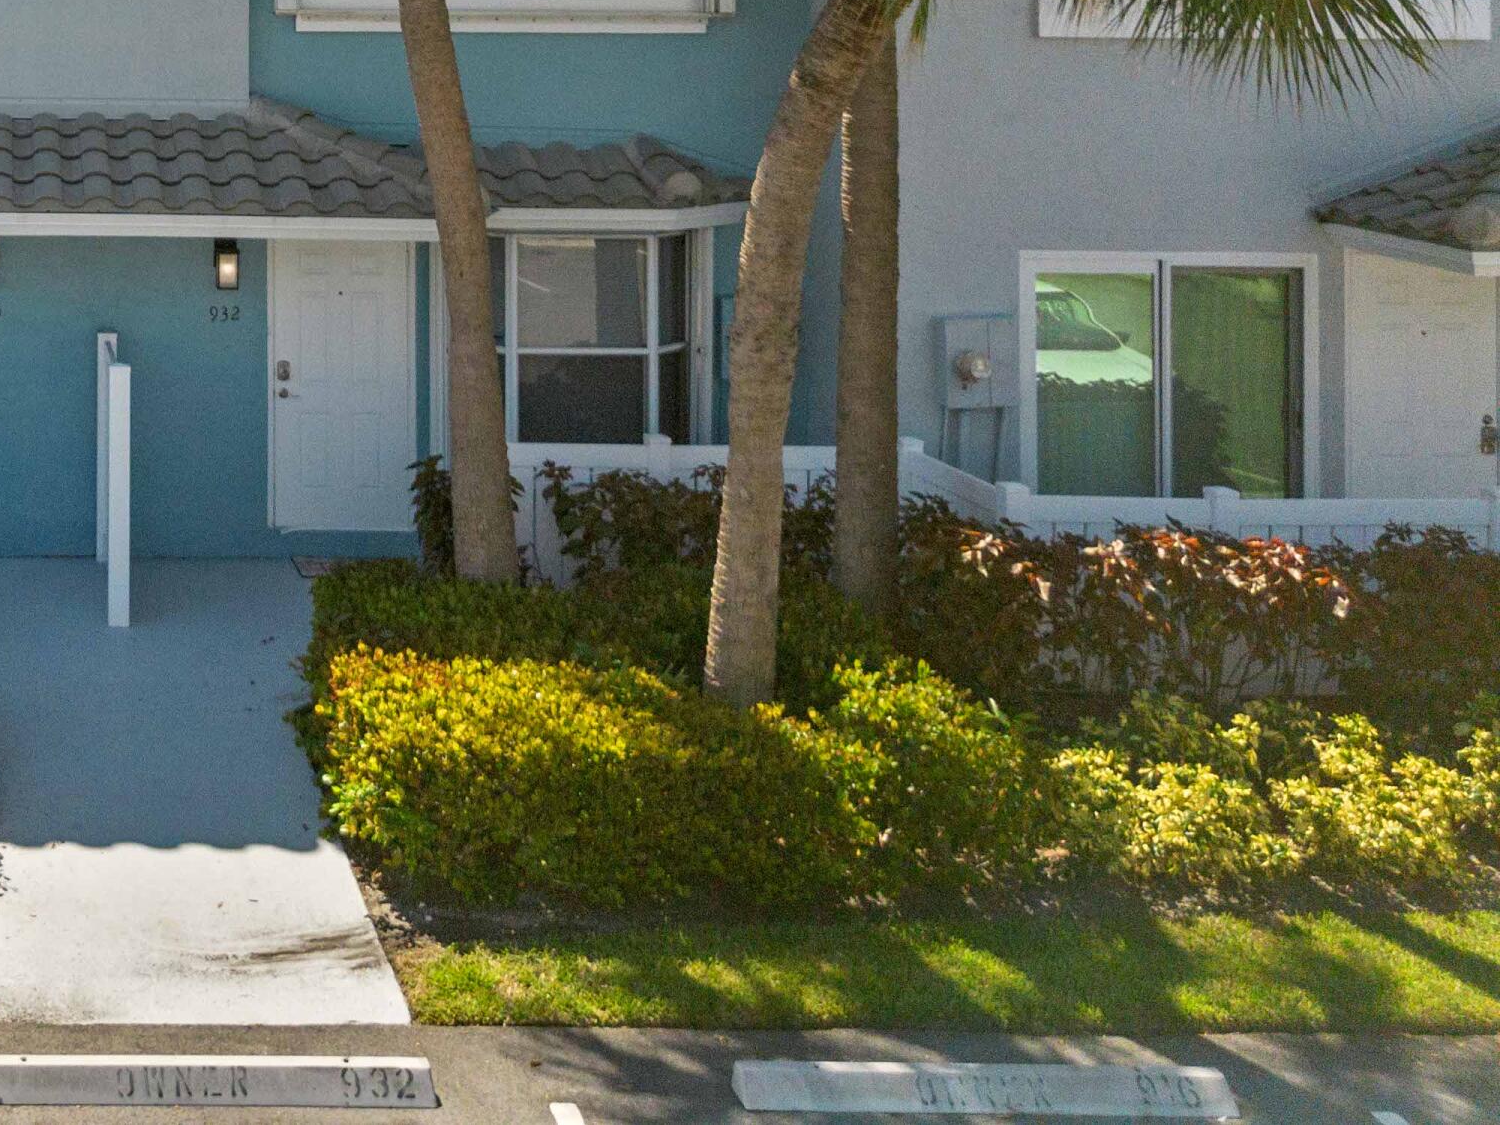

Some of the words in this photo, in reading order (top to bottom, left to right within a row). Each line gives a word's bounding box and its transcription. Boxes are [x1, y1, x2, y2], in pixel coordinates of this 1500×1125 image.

[209, 305, 240, 322] 932
[116, 1065, 248, 1098] OWNER
[340, 1067, 416, 1099] 932
